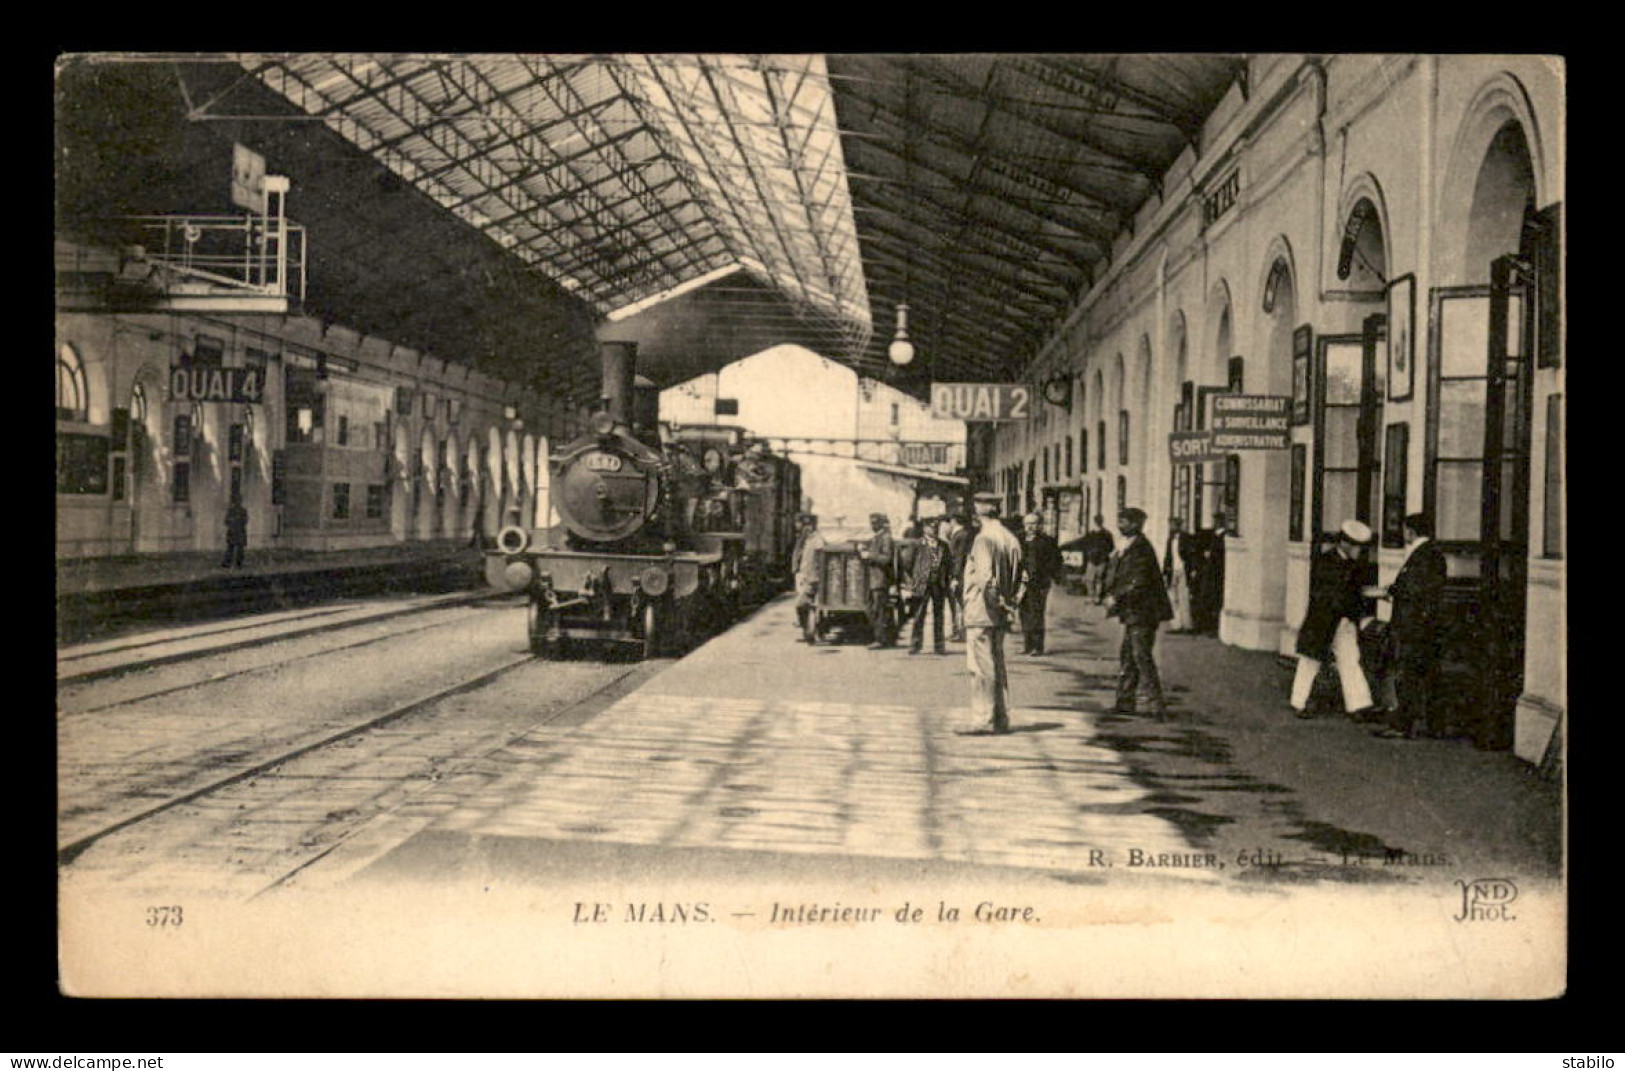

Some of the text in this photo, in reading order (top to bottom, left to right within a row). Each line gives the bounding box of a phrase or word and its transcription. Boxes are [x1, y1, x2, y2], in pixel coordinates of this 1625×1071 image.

[172, 369, 261, 401] QUAI 4
[937, 386, 1028, 419] QUAI 2
[1217, 397, 1285, 411] COMMISSARIAT
[1225, 416, 1287, 430] SURVEILLANCE
[1171, 438, 1224, 456] SORT
